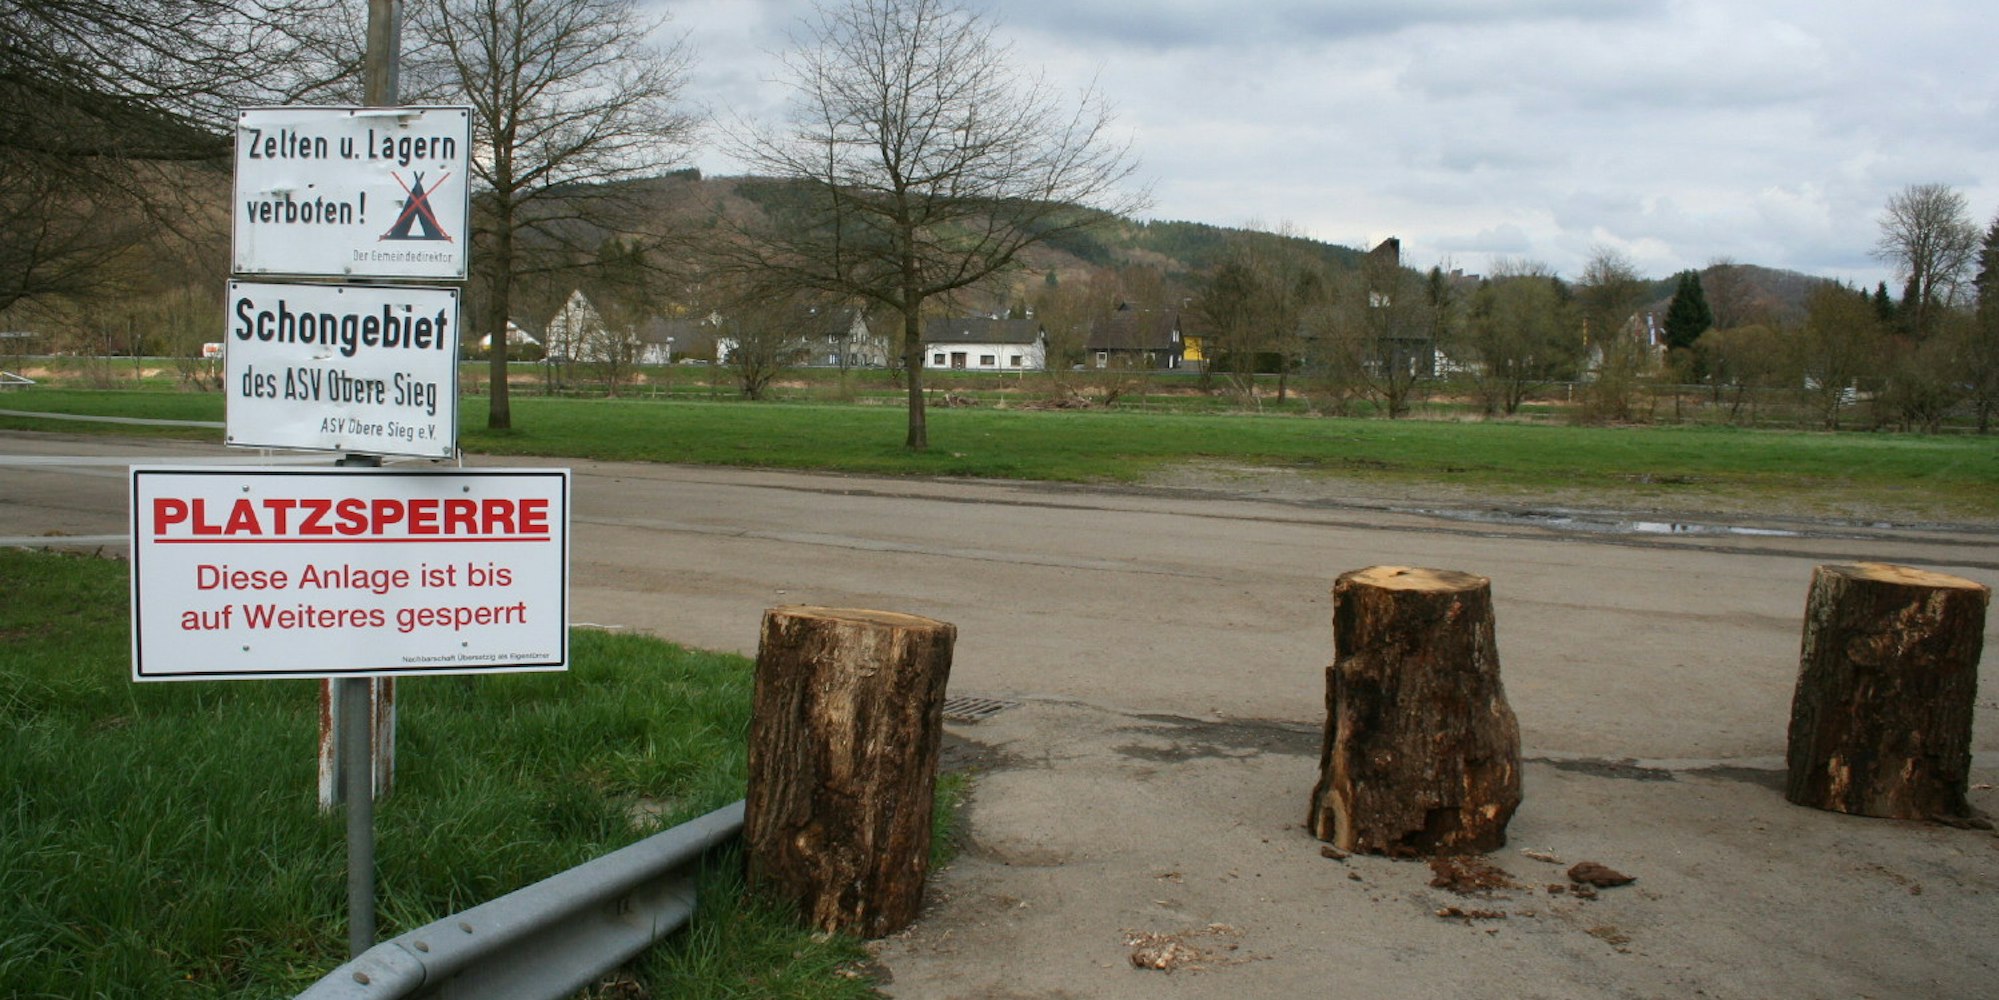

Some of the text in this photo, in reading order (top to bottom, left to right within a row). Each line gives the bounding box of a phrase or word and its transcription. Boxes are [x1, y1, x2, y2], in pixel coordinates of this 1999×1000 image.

[249, 129, 456, 167] Zelten u. Lagern
[353, 249, 453, 263] Der Gemeindedirektor
[236, 297, 447, 357] Schongebiet
[242, 364, 437, 416] des ASV Obere Sieg
[321, 417, 437, 441] ASV Obere Sieg e.V.
[153, 497, 550, 536] PLATZSPERRE
[196, 562, 513, 594] Diese Anlage ist bis
[181, 601, 527, 633] auf Weiteres gesperrt
